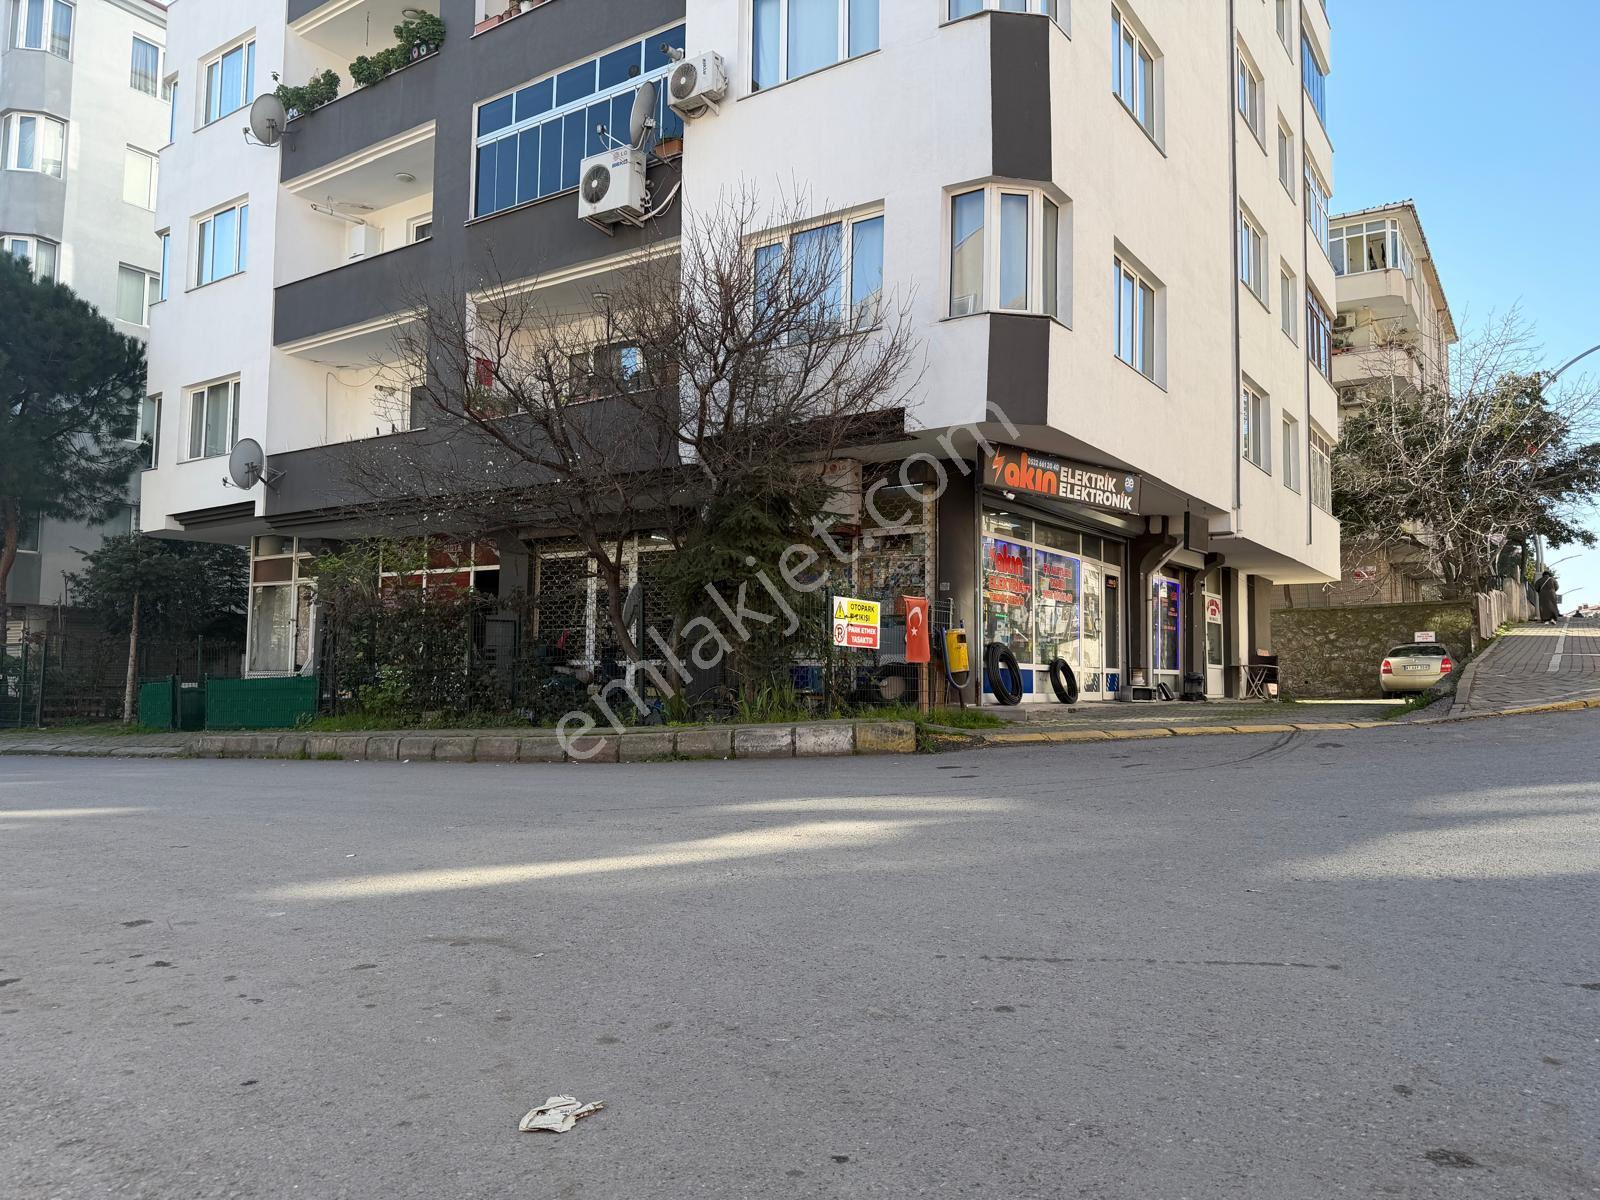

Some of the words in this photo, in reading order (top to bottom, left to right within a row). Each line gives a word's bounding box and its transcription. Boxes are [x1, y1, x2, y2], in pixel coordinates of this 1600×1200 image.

[1060, 466, 1117, 493] ELEKTRİK
[1059, 482, 1132, 510] ELEKTRONİK
[850, 603, 875, 612] OTOPARK
[860, 627, 877, 635] ETMEK
